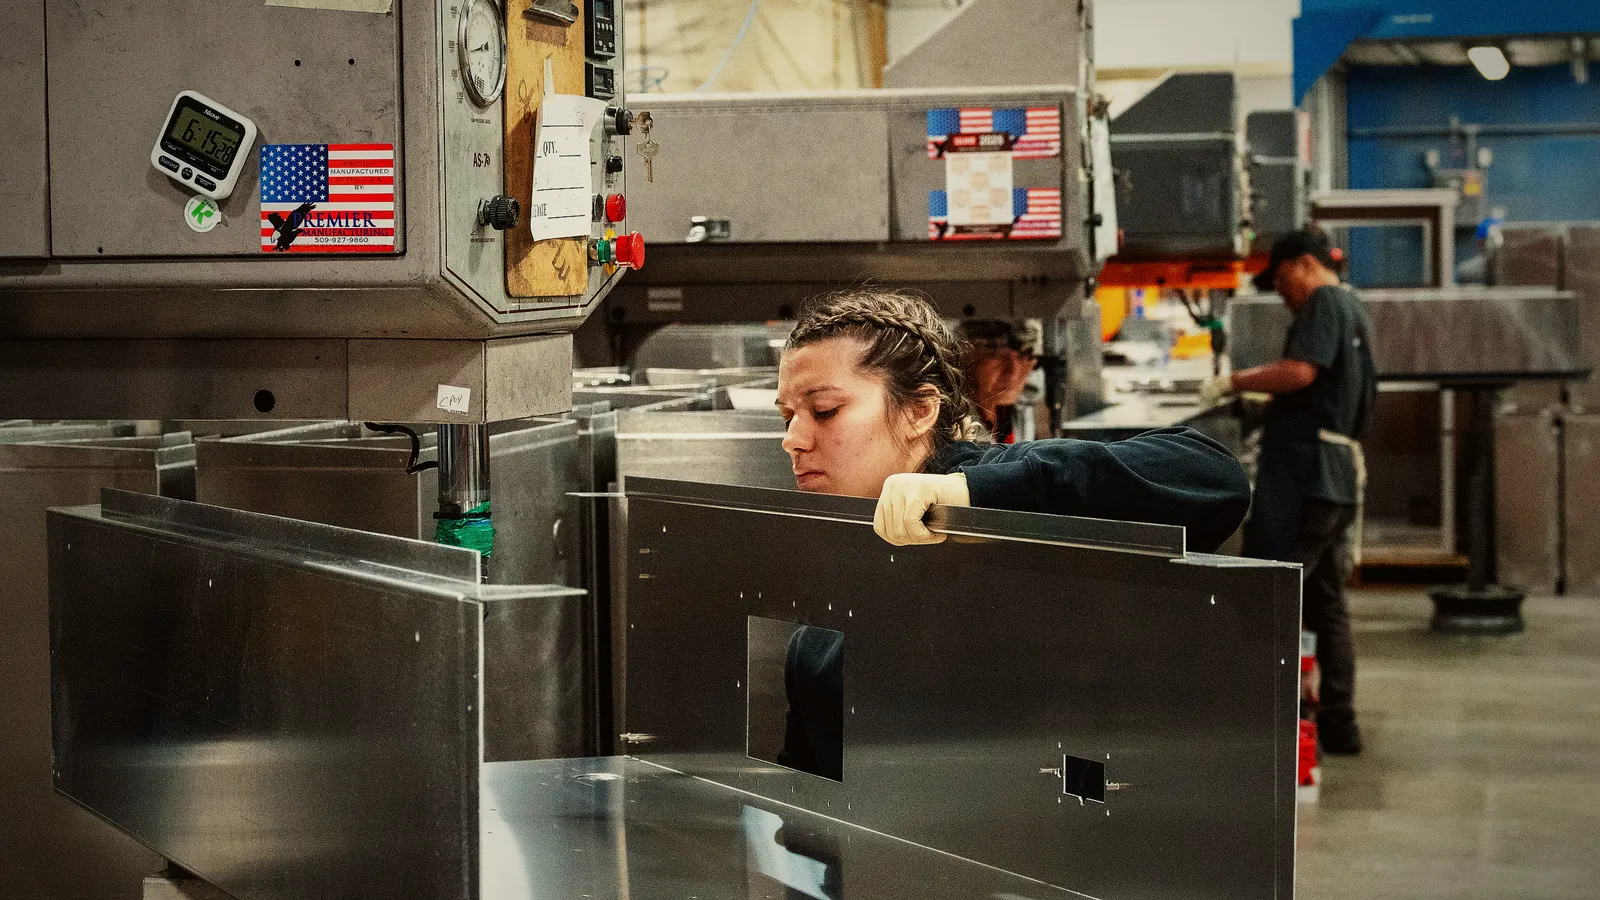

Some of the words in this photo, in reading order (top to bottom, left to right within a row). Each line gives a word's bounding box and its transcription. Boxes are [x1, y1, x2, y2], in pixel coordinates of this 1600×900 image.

[182, 118, 223, 156] 6:15
[543, 141, 558, 156] QTY.
[293, 211, 376, 228] PREMIER
[302, 228, 388, 236] MANUFACTURING
